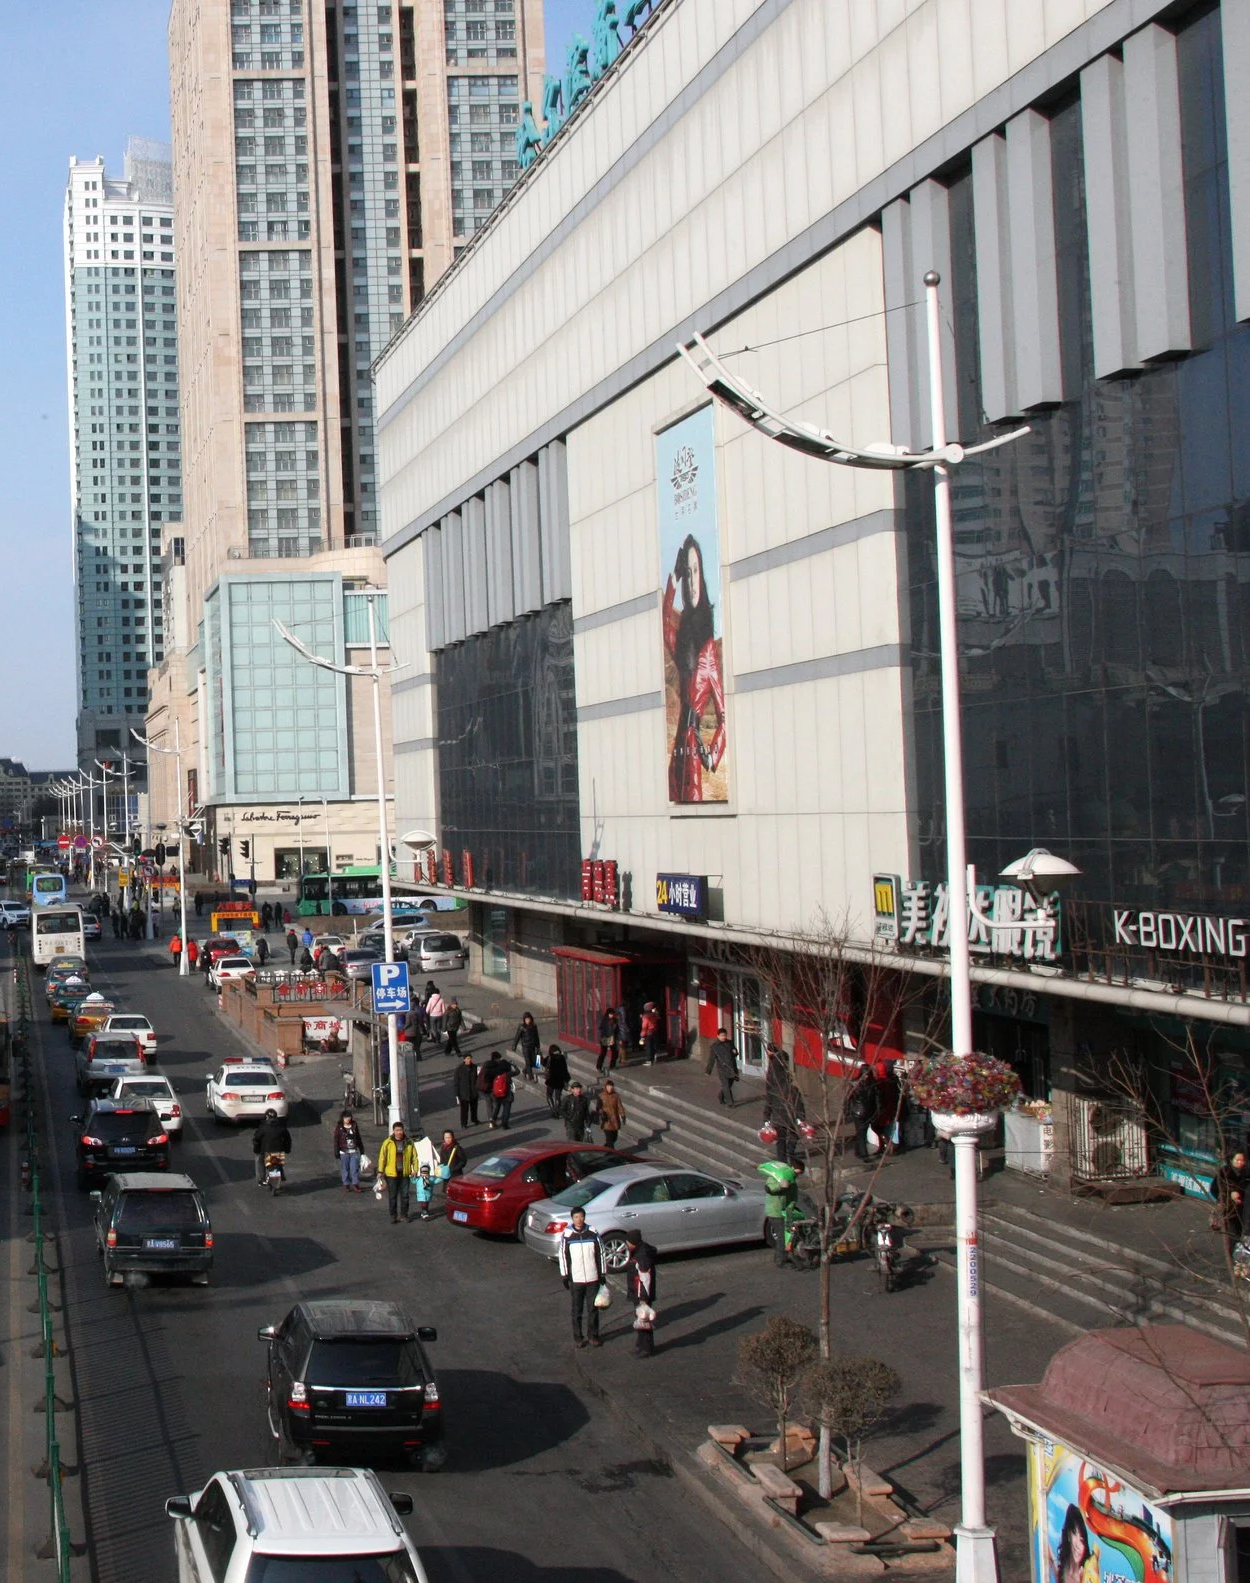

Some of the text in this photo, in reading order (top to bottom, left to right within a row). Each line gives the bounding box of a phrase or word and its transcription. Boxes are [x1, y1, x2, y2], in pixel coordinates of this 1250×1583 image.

[241, 810, 321, 826] Salvatore Ferragamo
[1113, 910, 1249, 957] K-BOXING
[379, 964, 400, 987] P
[376, 986, 407, 1000] 停车场
